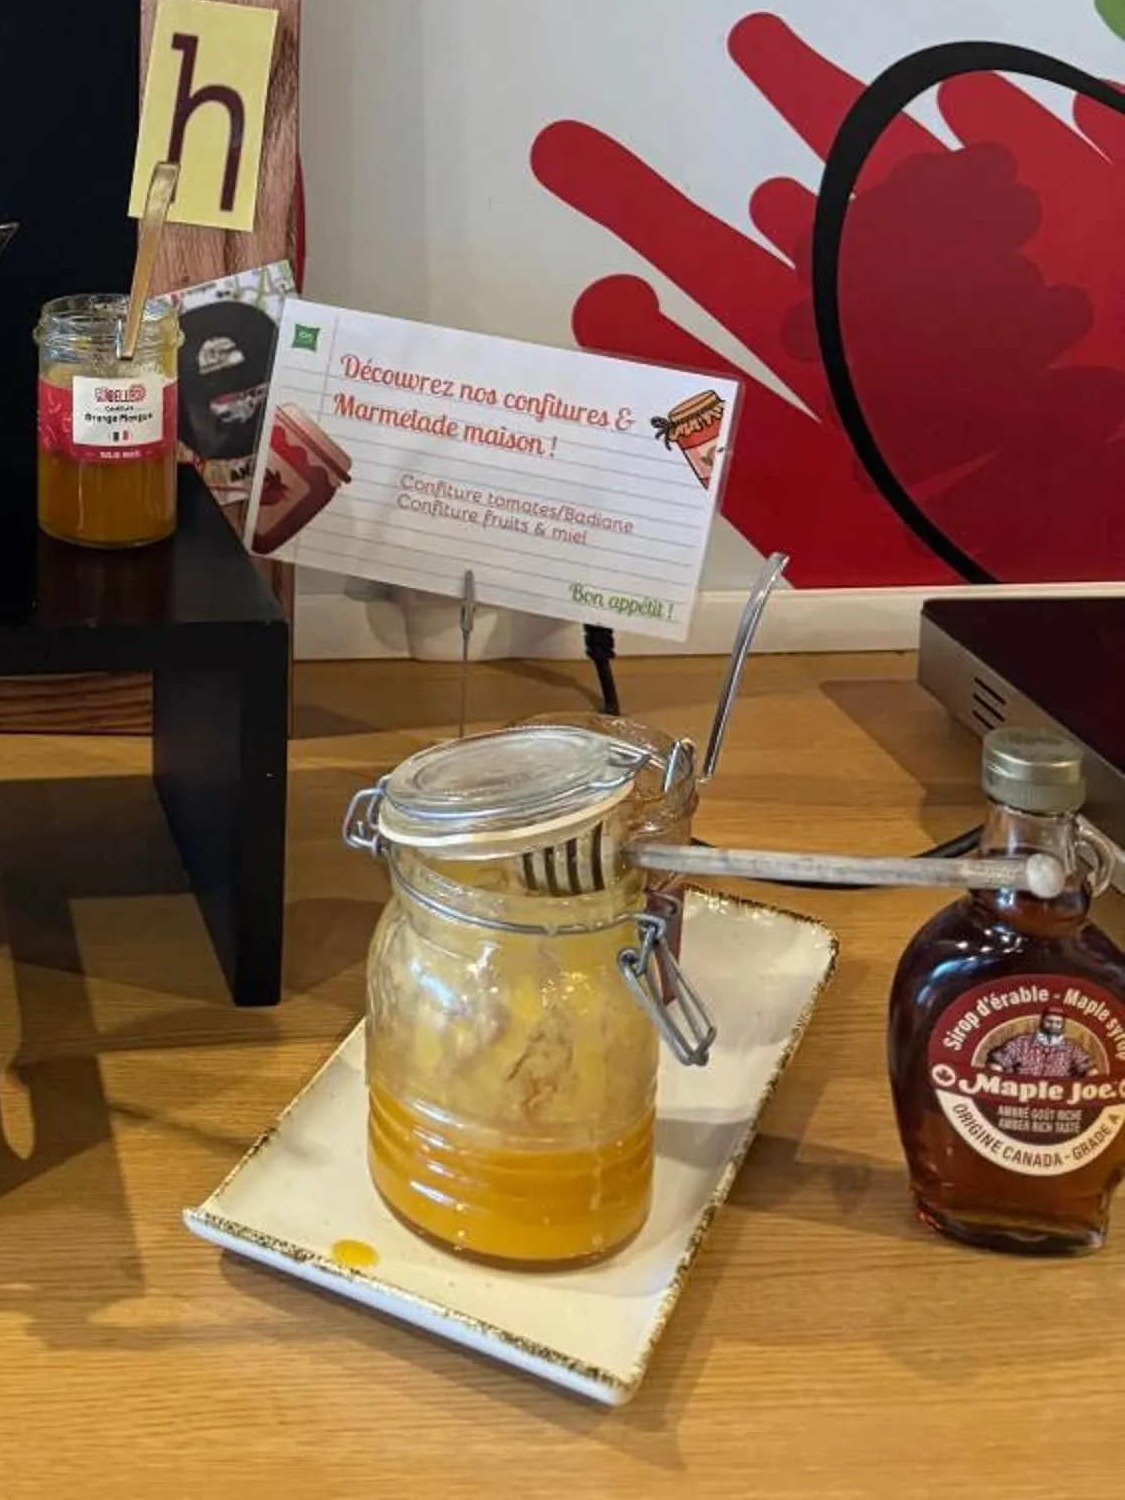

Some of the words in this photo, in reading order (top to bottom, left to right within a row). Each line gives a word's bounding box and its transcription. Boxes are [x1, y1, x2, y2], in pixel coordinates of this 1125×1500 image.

[340, 353, 454, 398] Découvrez
[459, 383, 497, 406] nos
[503, 392, 609, 427] confitures
[614, 406, 636, 431] &
[334, 392, 460, 438] Marmelade
[463, 423, 545, 455] maison
[400, 473, 483, 503] Confiture
[397, 492, 479, 523] Confiture
[481, 509, 533, 534] fruits
[533, 521, 547, 538] &
[551, 526, 588, 546] miel
[569, 581, 604, 606] Bon
[942, 1013, 980, 1051] Sirop
[976, 985, 1050, 1022] d'érable
[1062, 987, 1110, 1023] Maple
[958, 1072, 1065, 1103] Maple
[951, 1102, 1003, 1155] ORIGINE
[1001, 1145, 1064, 1169] CANADA
[1071, 1123, 1112, 1162] GRADE
